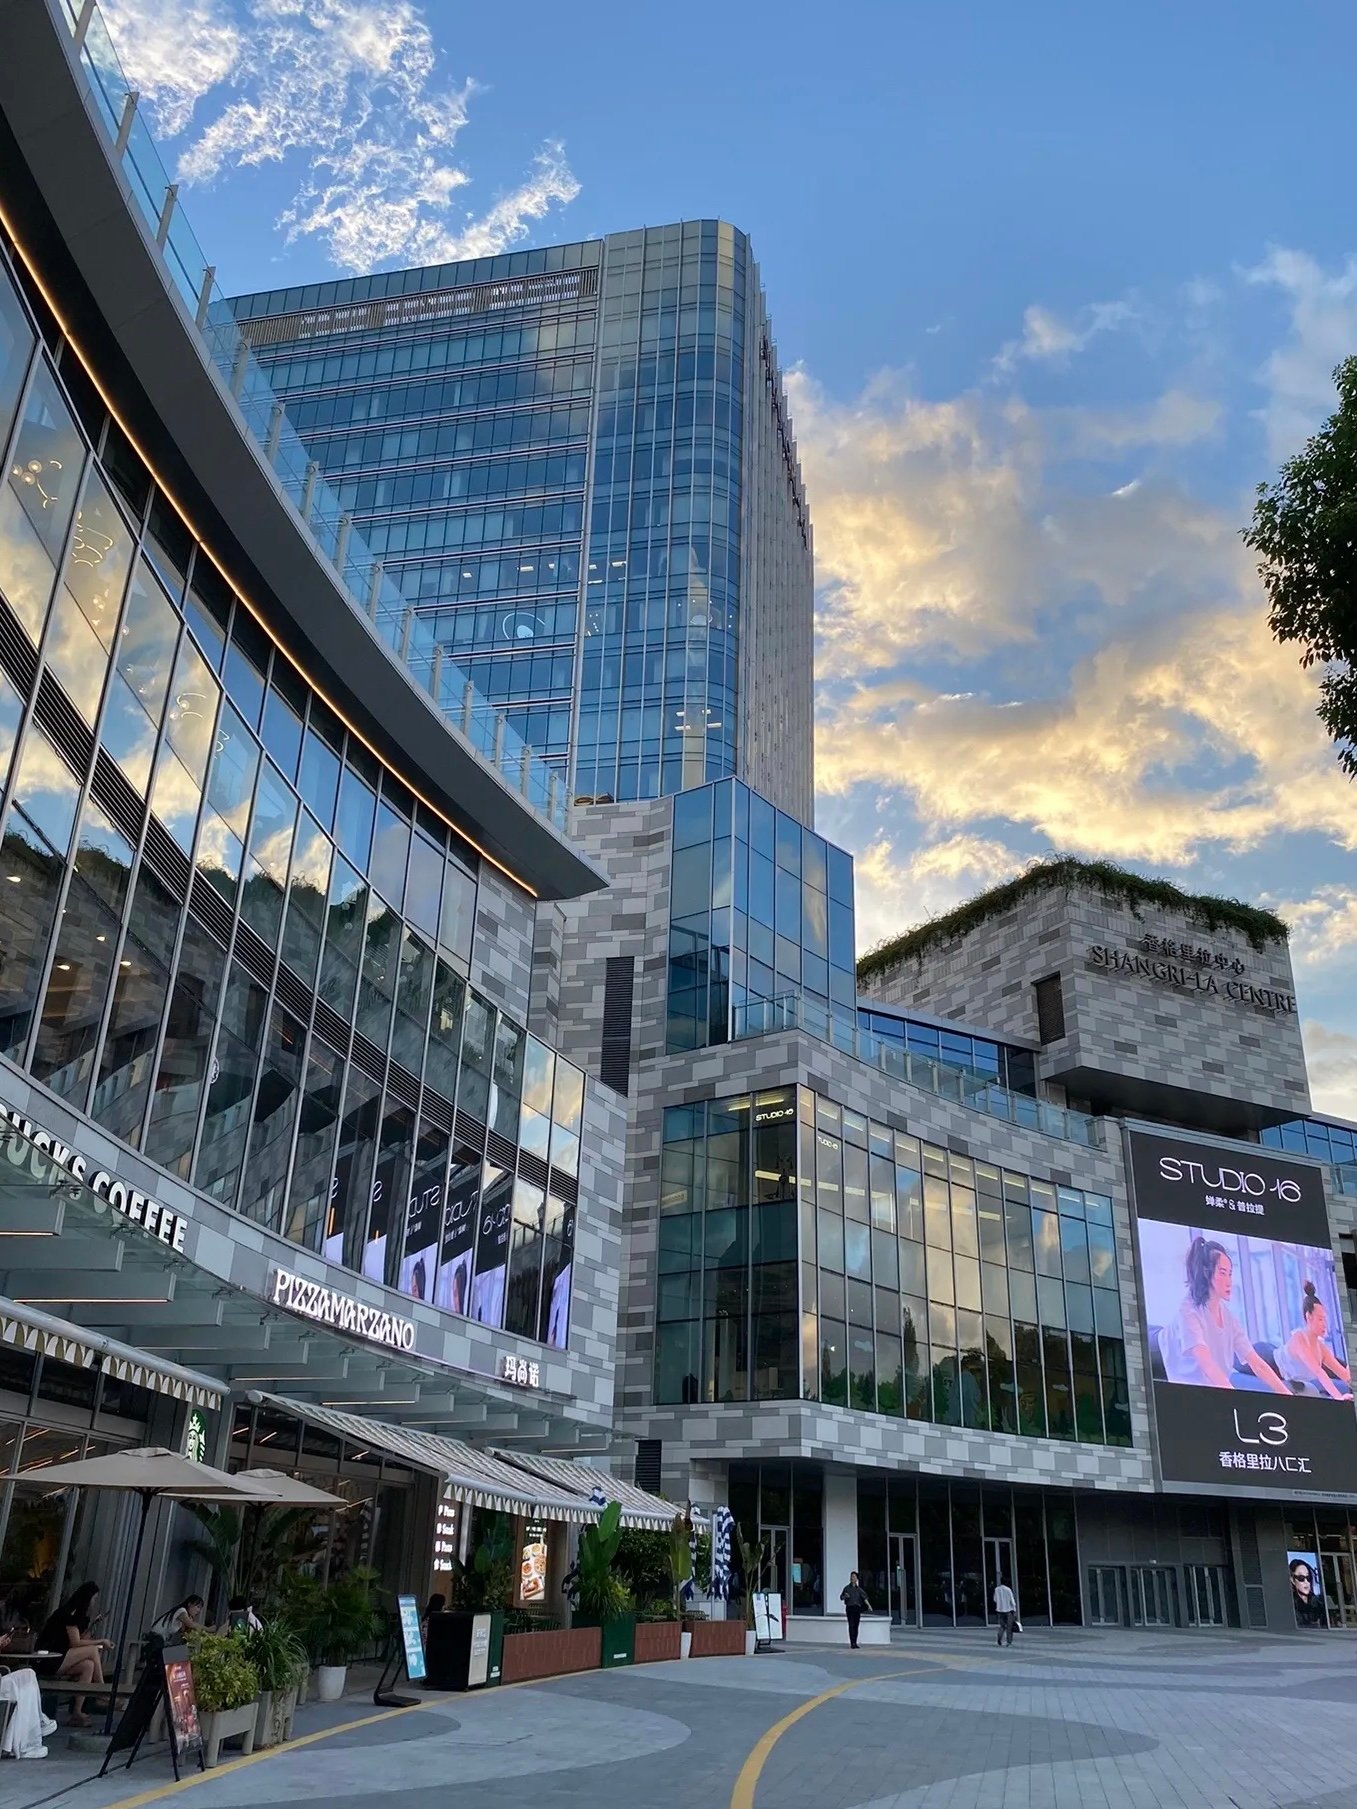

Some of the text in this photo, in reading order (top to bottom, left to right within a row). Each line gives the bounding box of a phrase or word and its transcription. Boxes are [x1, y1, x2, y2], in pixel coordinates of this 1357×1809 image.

[1141, 933, 1246, 978] 香格里拉中心
[1091, 946, 1297, 1015] SHANGRI-LA CENTRE
[756, 1110, 784, 1121] STUDIO
[1159, 1157, 1266, 1196] STUDIO
[91, 1171, 189, 1254] COFFEE
[273, 1268, 416, 1350] PIZZAMARZANO
[1233, 1408, 1288, 1446] L3
